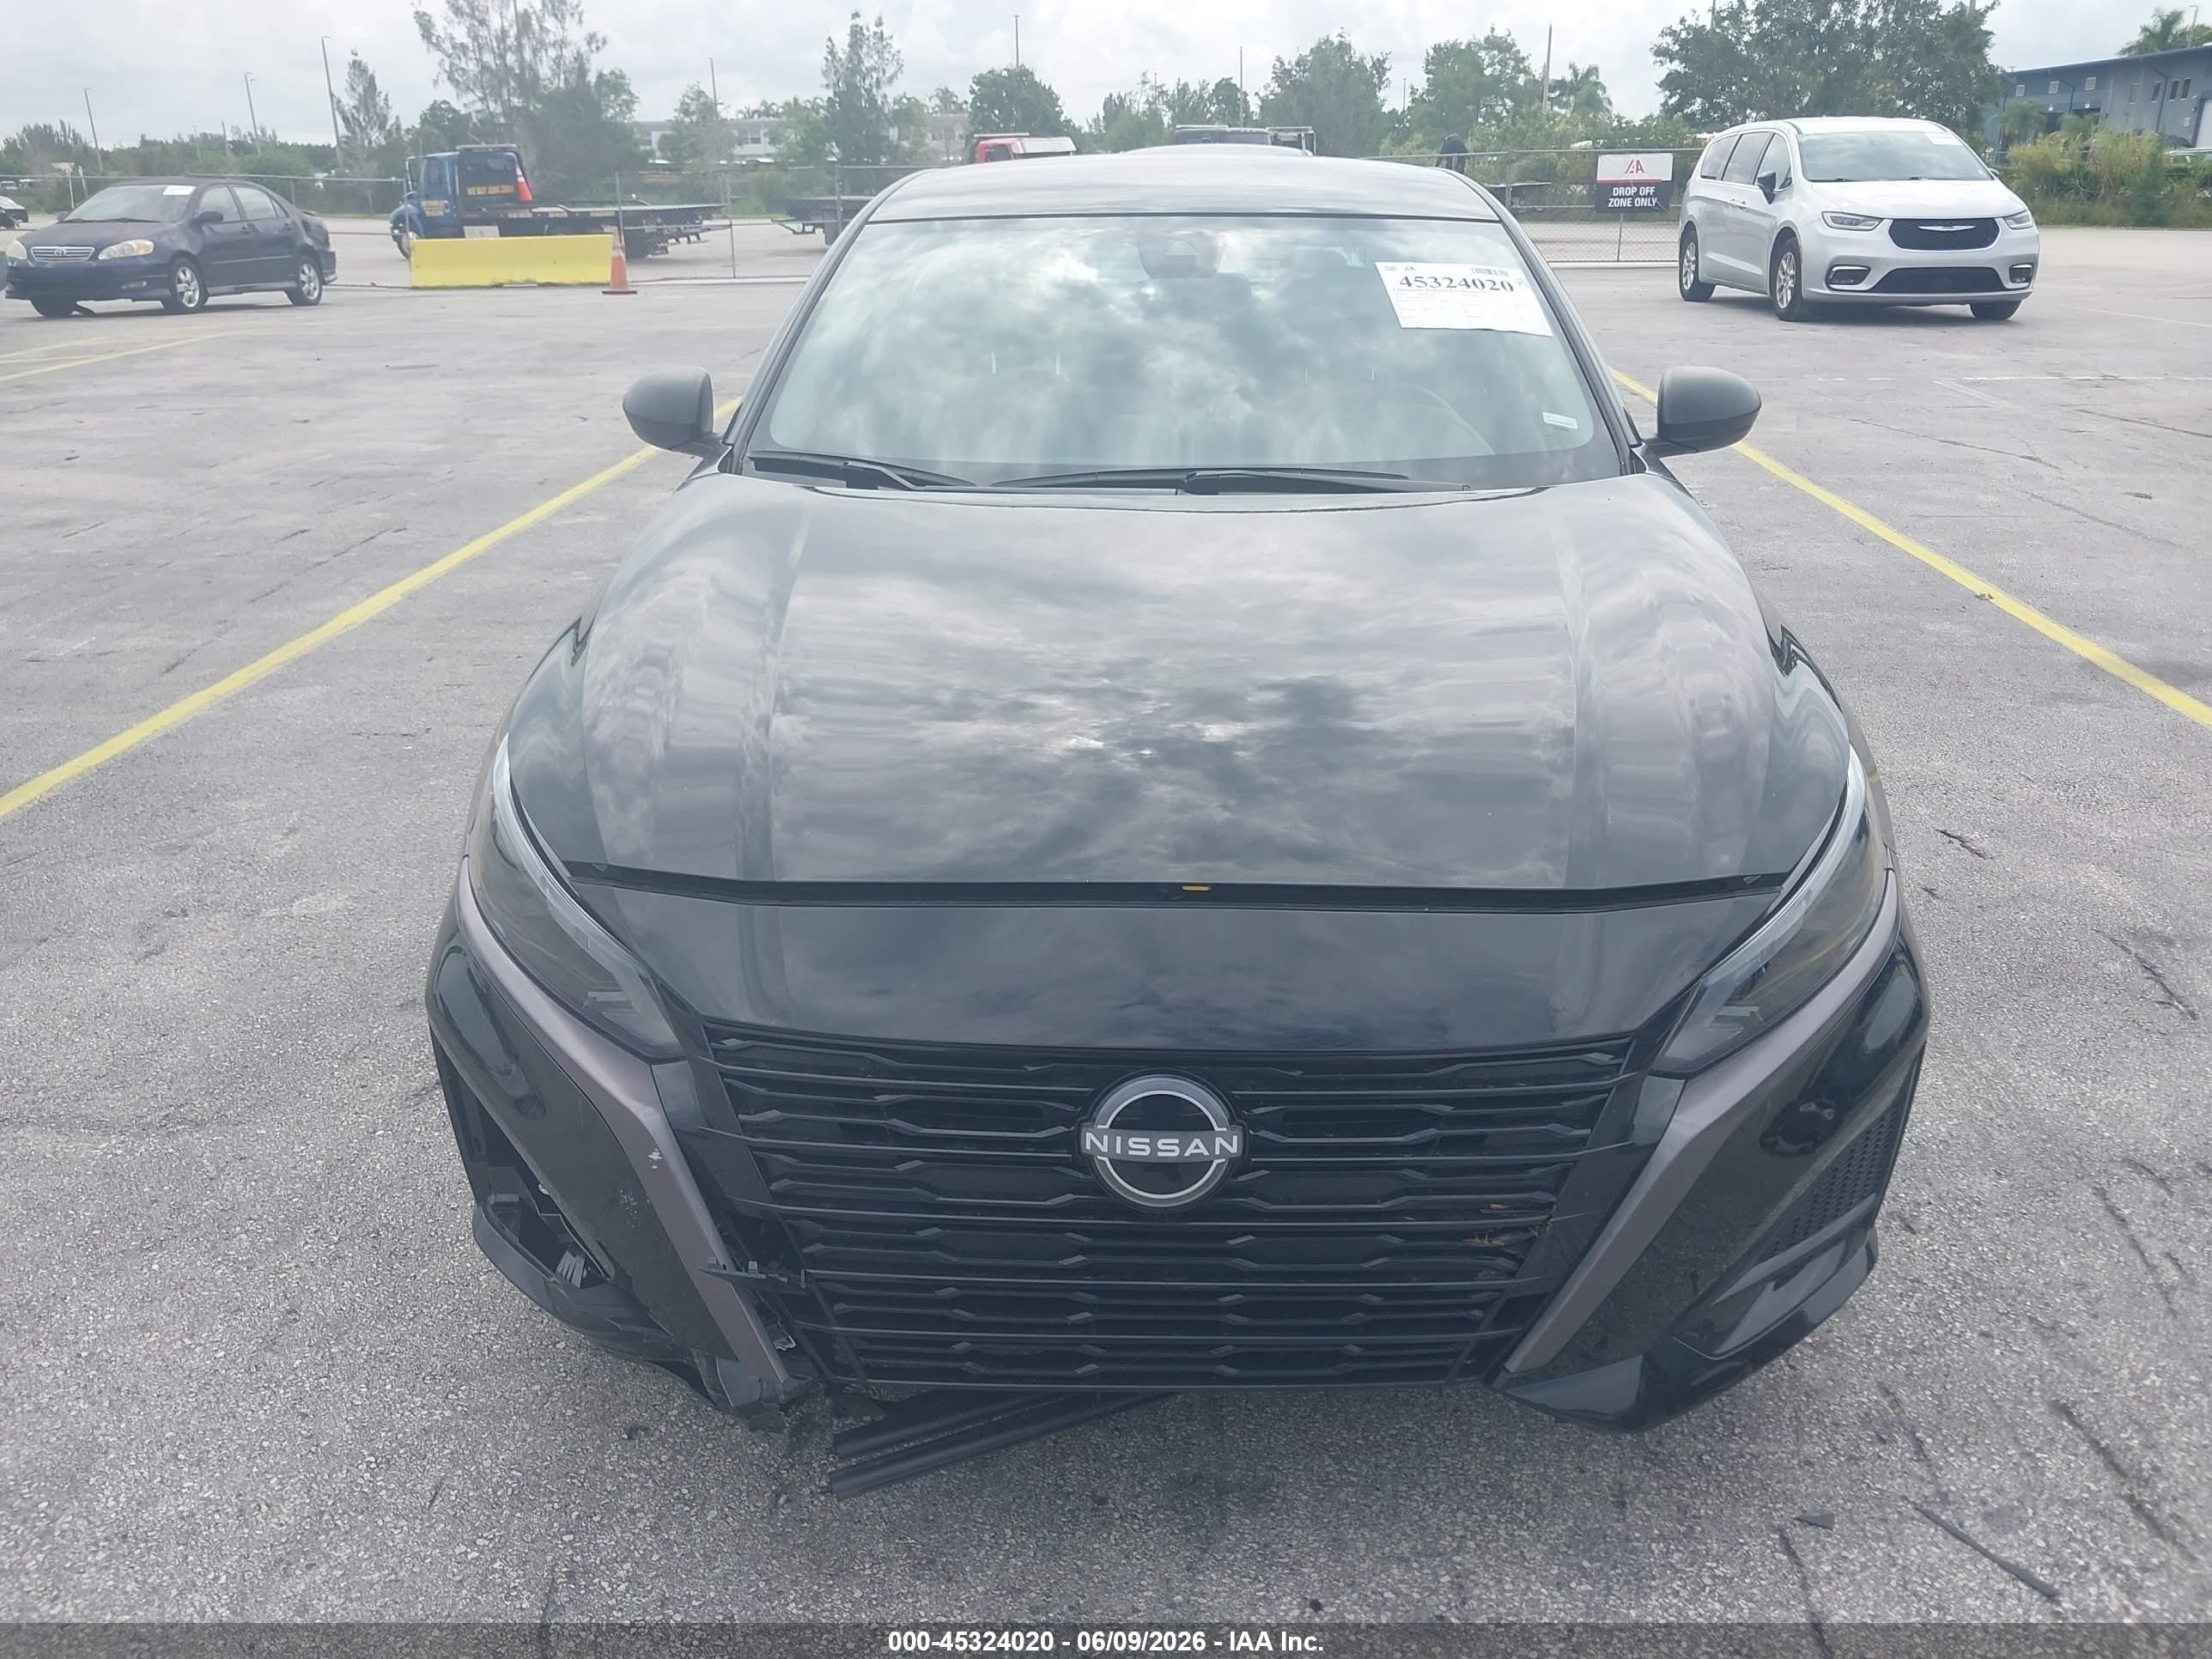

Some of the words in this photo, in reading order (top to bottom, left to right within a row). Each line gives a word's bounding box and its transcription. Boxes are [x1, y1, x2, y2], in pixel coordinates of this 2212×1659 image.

[1613, 186, 1637, 196] DROP
[1639, 186, 1656, 196] OFF
[1608, 198, 1632, 207] ZONE
[1634, 198, 1657, 207] ONLY
[1400, 276, 1514, 292] 45324020
[1085, 1132, 1237, 1157] NISSAN
